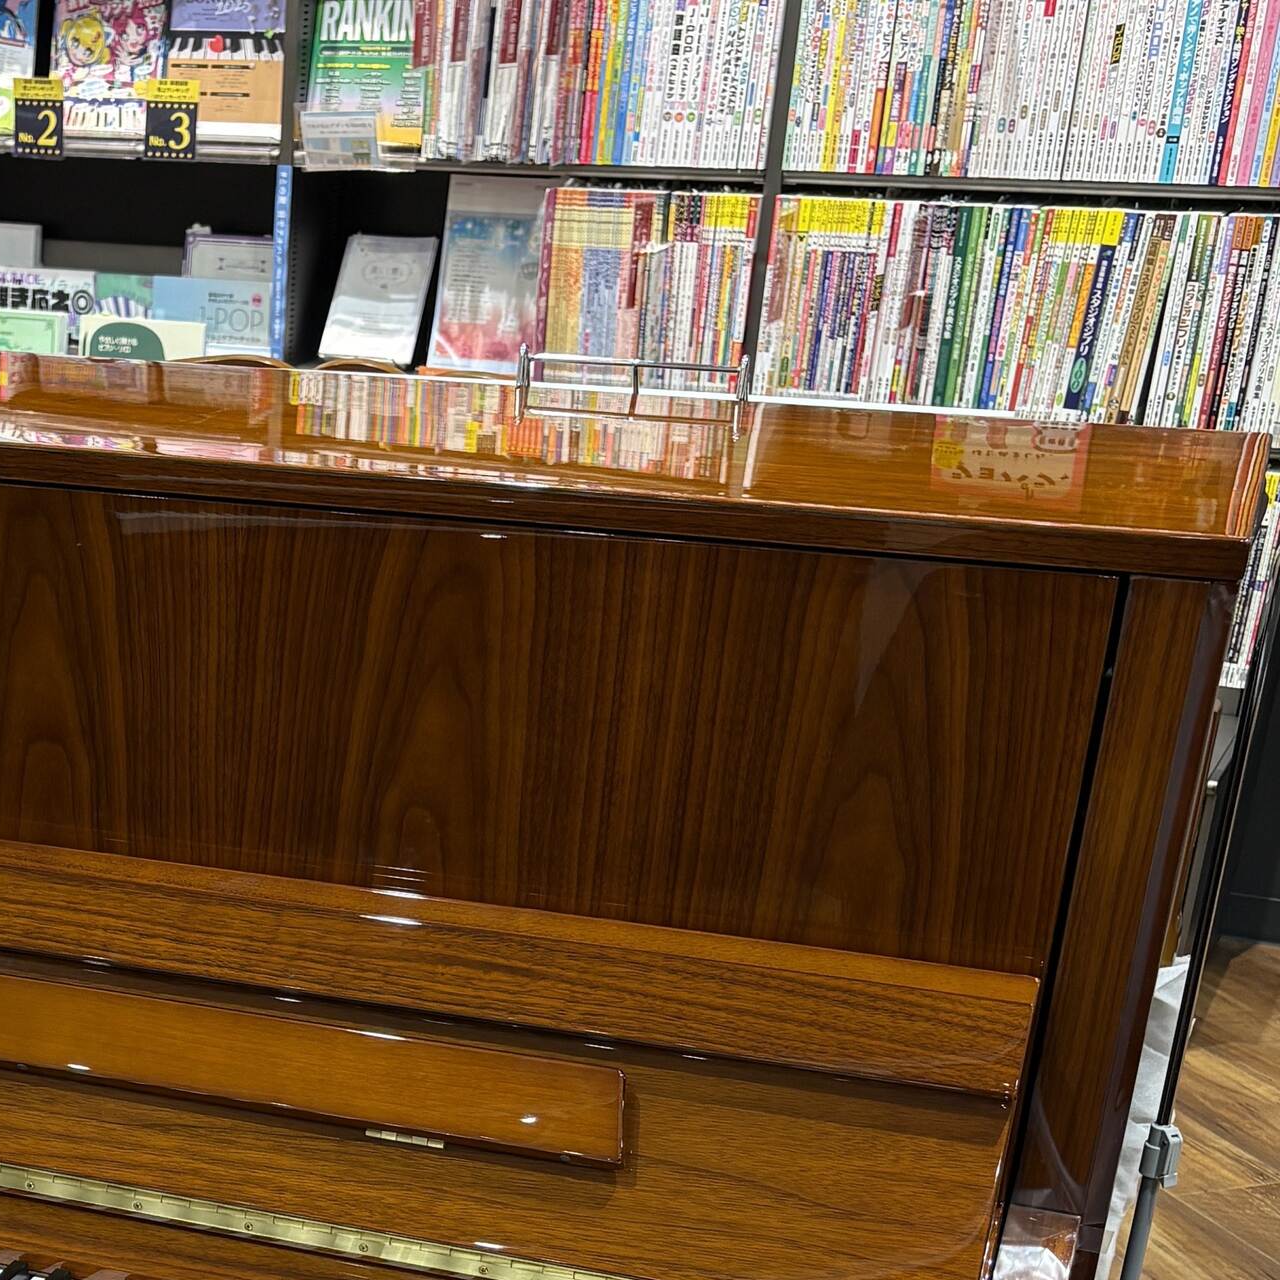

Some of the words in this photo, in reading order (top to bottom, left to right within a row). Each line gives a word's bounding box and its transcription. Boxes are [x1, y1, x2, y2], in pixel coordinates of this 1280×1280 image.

[1079, 290, 1102, 356] スタジオジブリ
